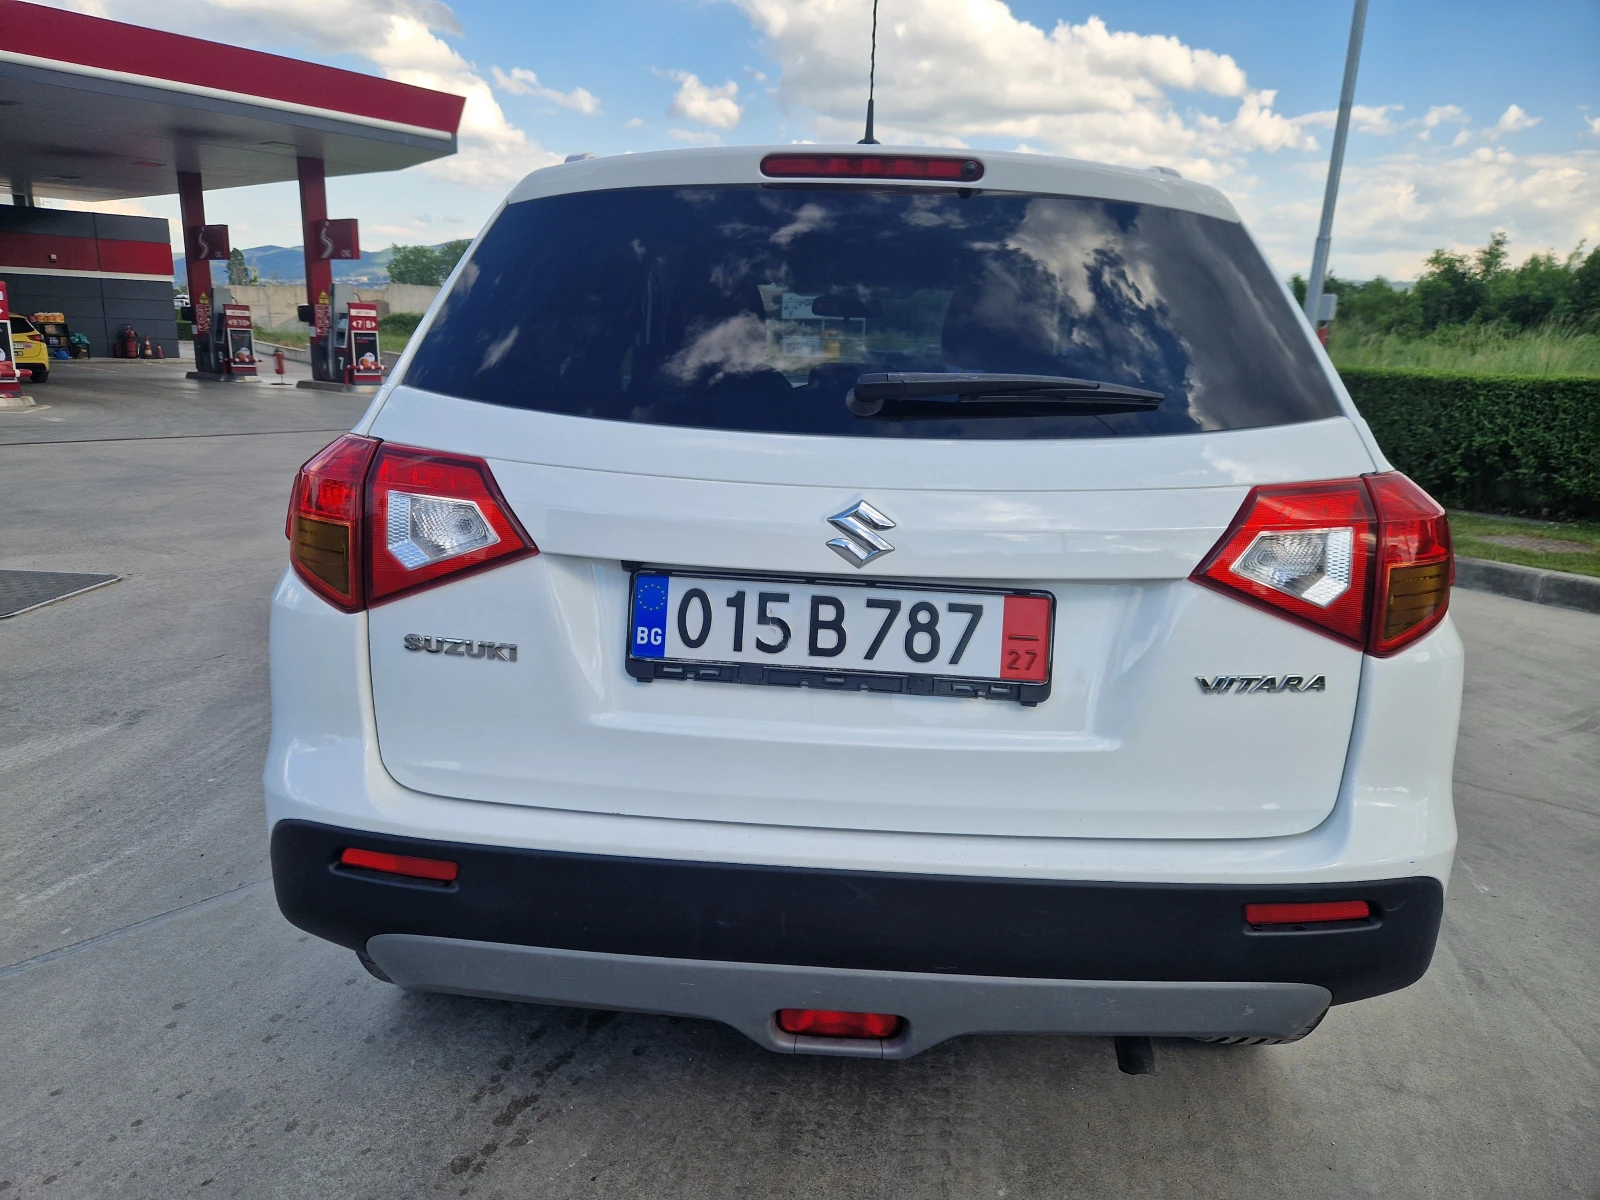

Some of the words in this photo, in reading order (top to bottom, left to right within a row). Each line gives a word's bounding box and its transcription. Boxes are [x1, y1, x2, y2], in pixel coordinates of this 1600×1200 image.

[356, 320, 363, 328] 7
[366, 320, 371, 328] 8
[338, 356, 344, 370] 7
[637, 626, 662, 644] BG
[677, 588, 791, 653] 015
[809, 594, 847, 657] B
[863, 598, 984, 665] 787
[404, 633, 518, 662] SUZUKI
[1007, 648, 1038, 671] 27
[1195, 673, 1326, 695] VITARA
